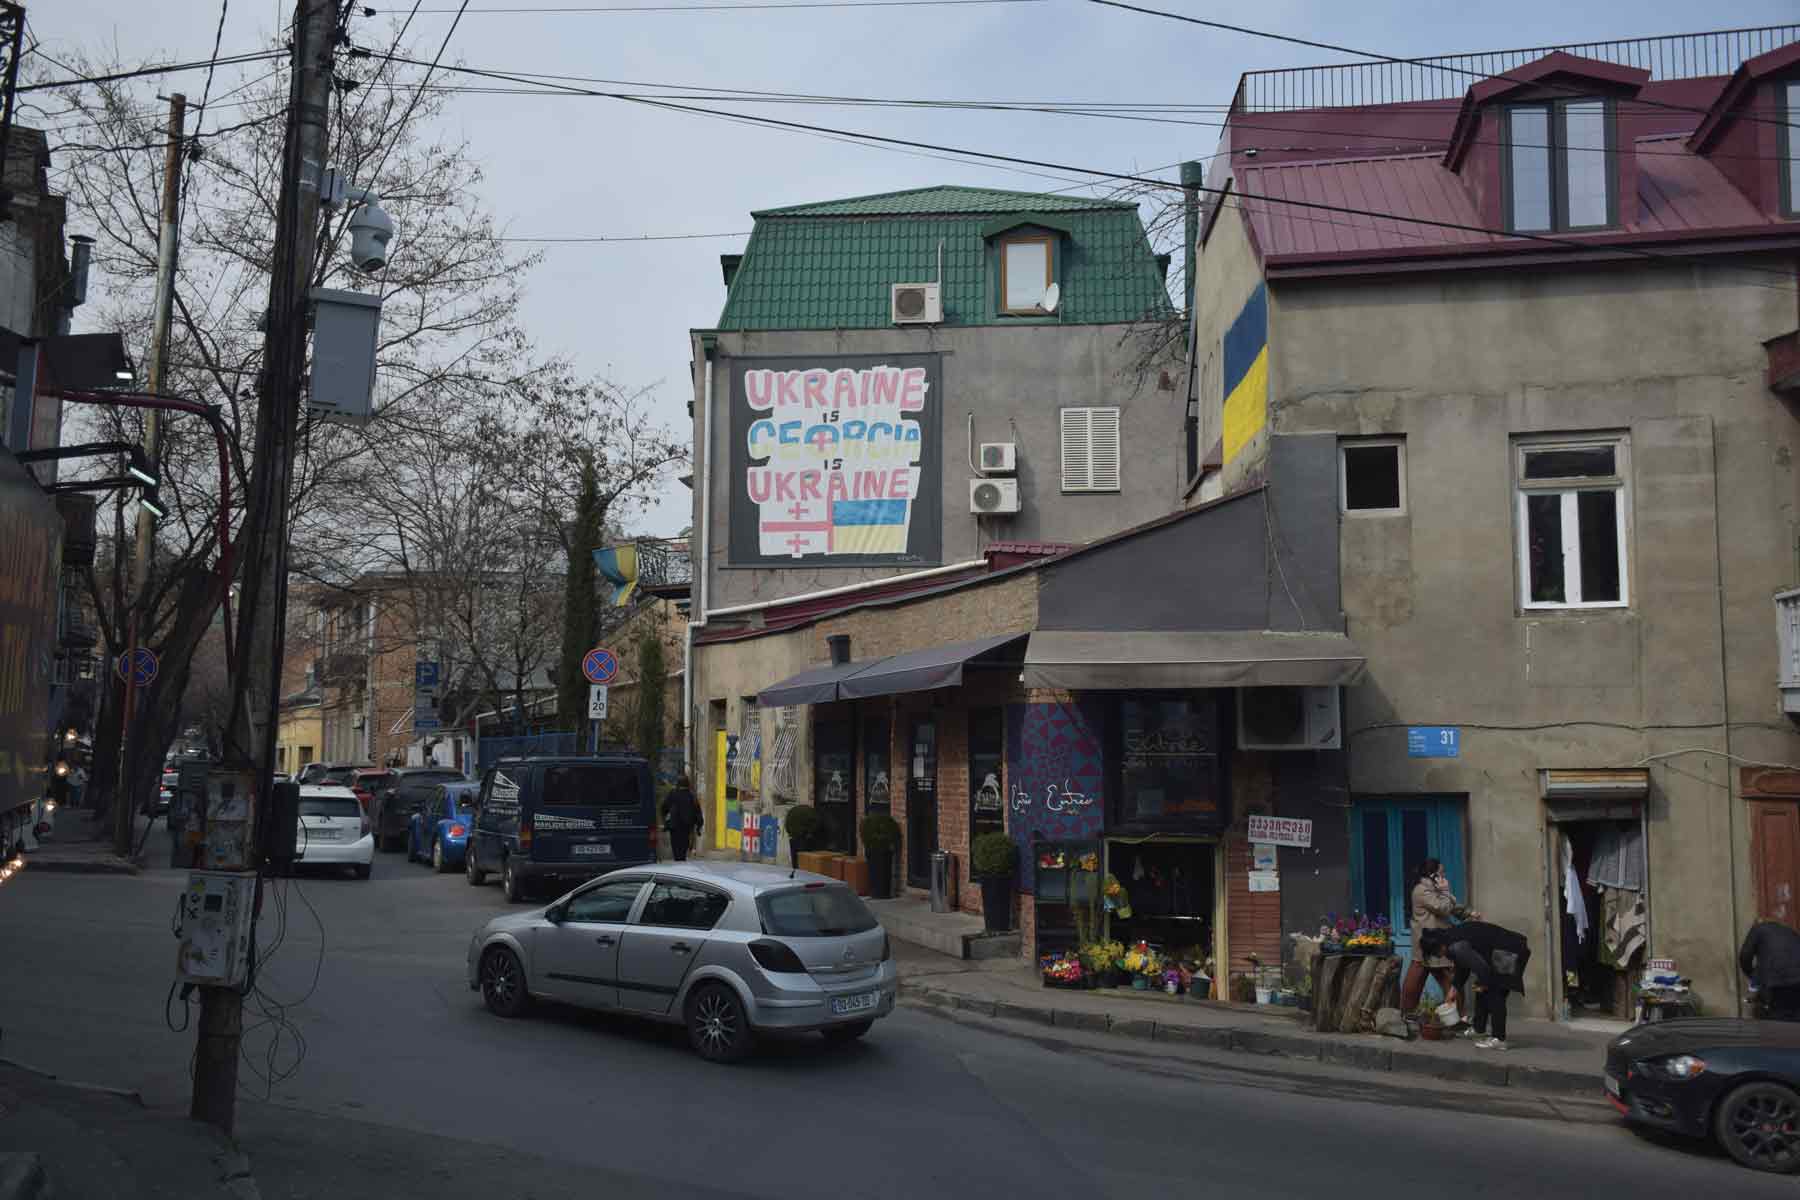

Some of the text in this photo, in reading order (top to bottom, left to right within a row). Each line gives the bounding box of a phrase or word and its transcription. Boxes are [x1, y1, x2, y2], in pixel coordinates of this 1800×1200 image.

[747, 370, 926, 410] UKRAINE
[749, 469, 910, 504] UKRAINE
[592, 702, 605, 711] 20
[1440, 730, 1454, 744] 31
